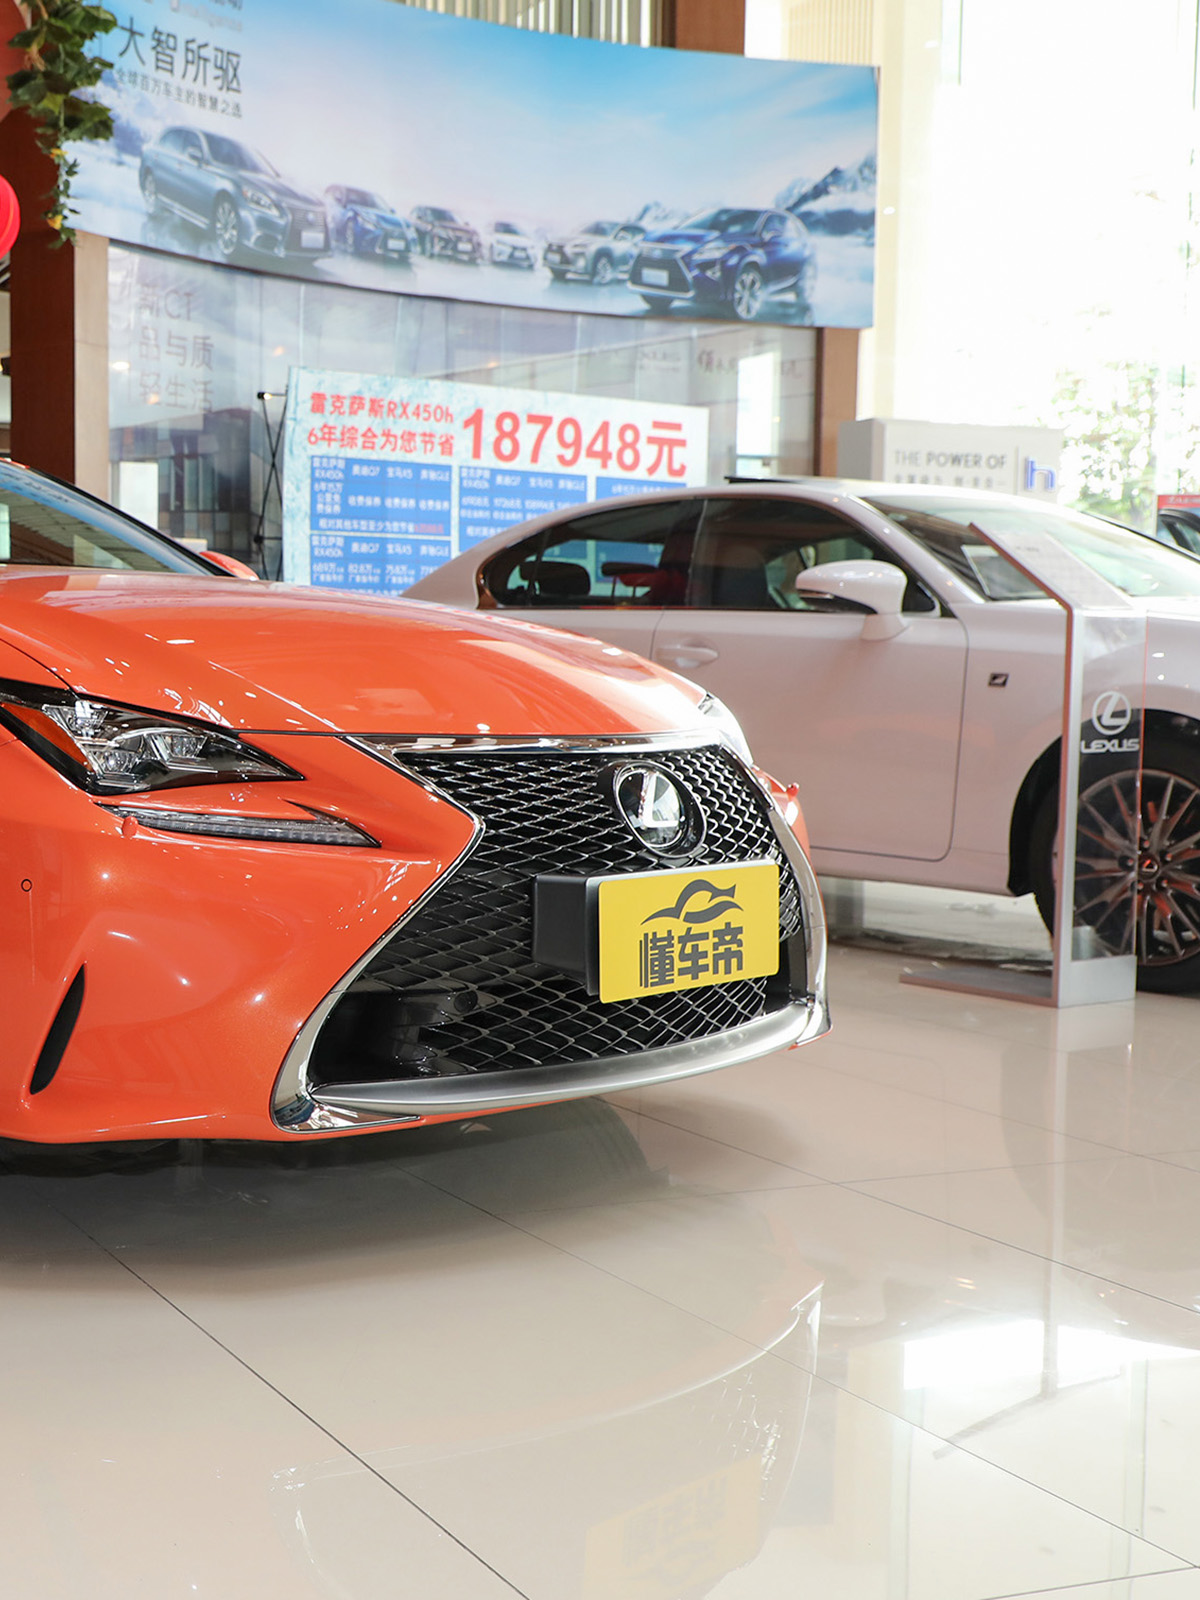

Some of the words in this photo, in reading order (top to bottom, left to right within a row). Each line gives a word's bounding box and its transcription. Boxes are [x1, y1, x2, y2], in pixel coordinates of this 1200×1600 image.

[118, 16, 242, 94] 大智所驱
[139, 325, 214, 371] 品与质
[310, 392, 454, 424] 雷克萨斯RX450h
[307, 423, 455, 456] 6年综合为您节省
[462, 408, 687, 478] 187948元
[894, 449, 920, 466] THE
[926, 450, 982, 469] POWER
[986, 453, 1007, 469] OF
[1080, 738, 1140, 753] LEXUS
[639, 922, 743, 988] 懂车帝
